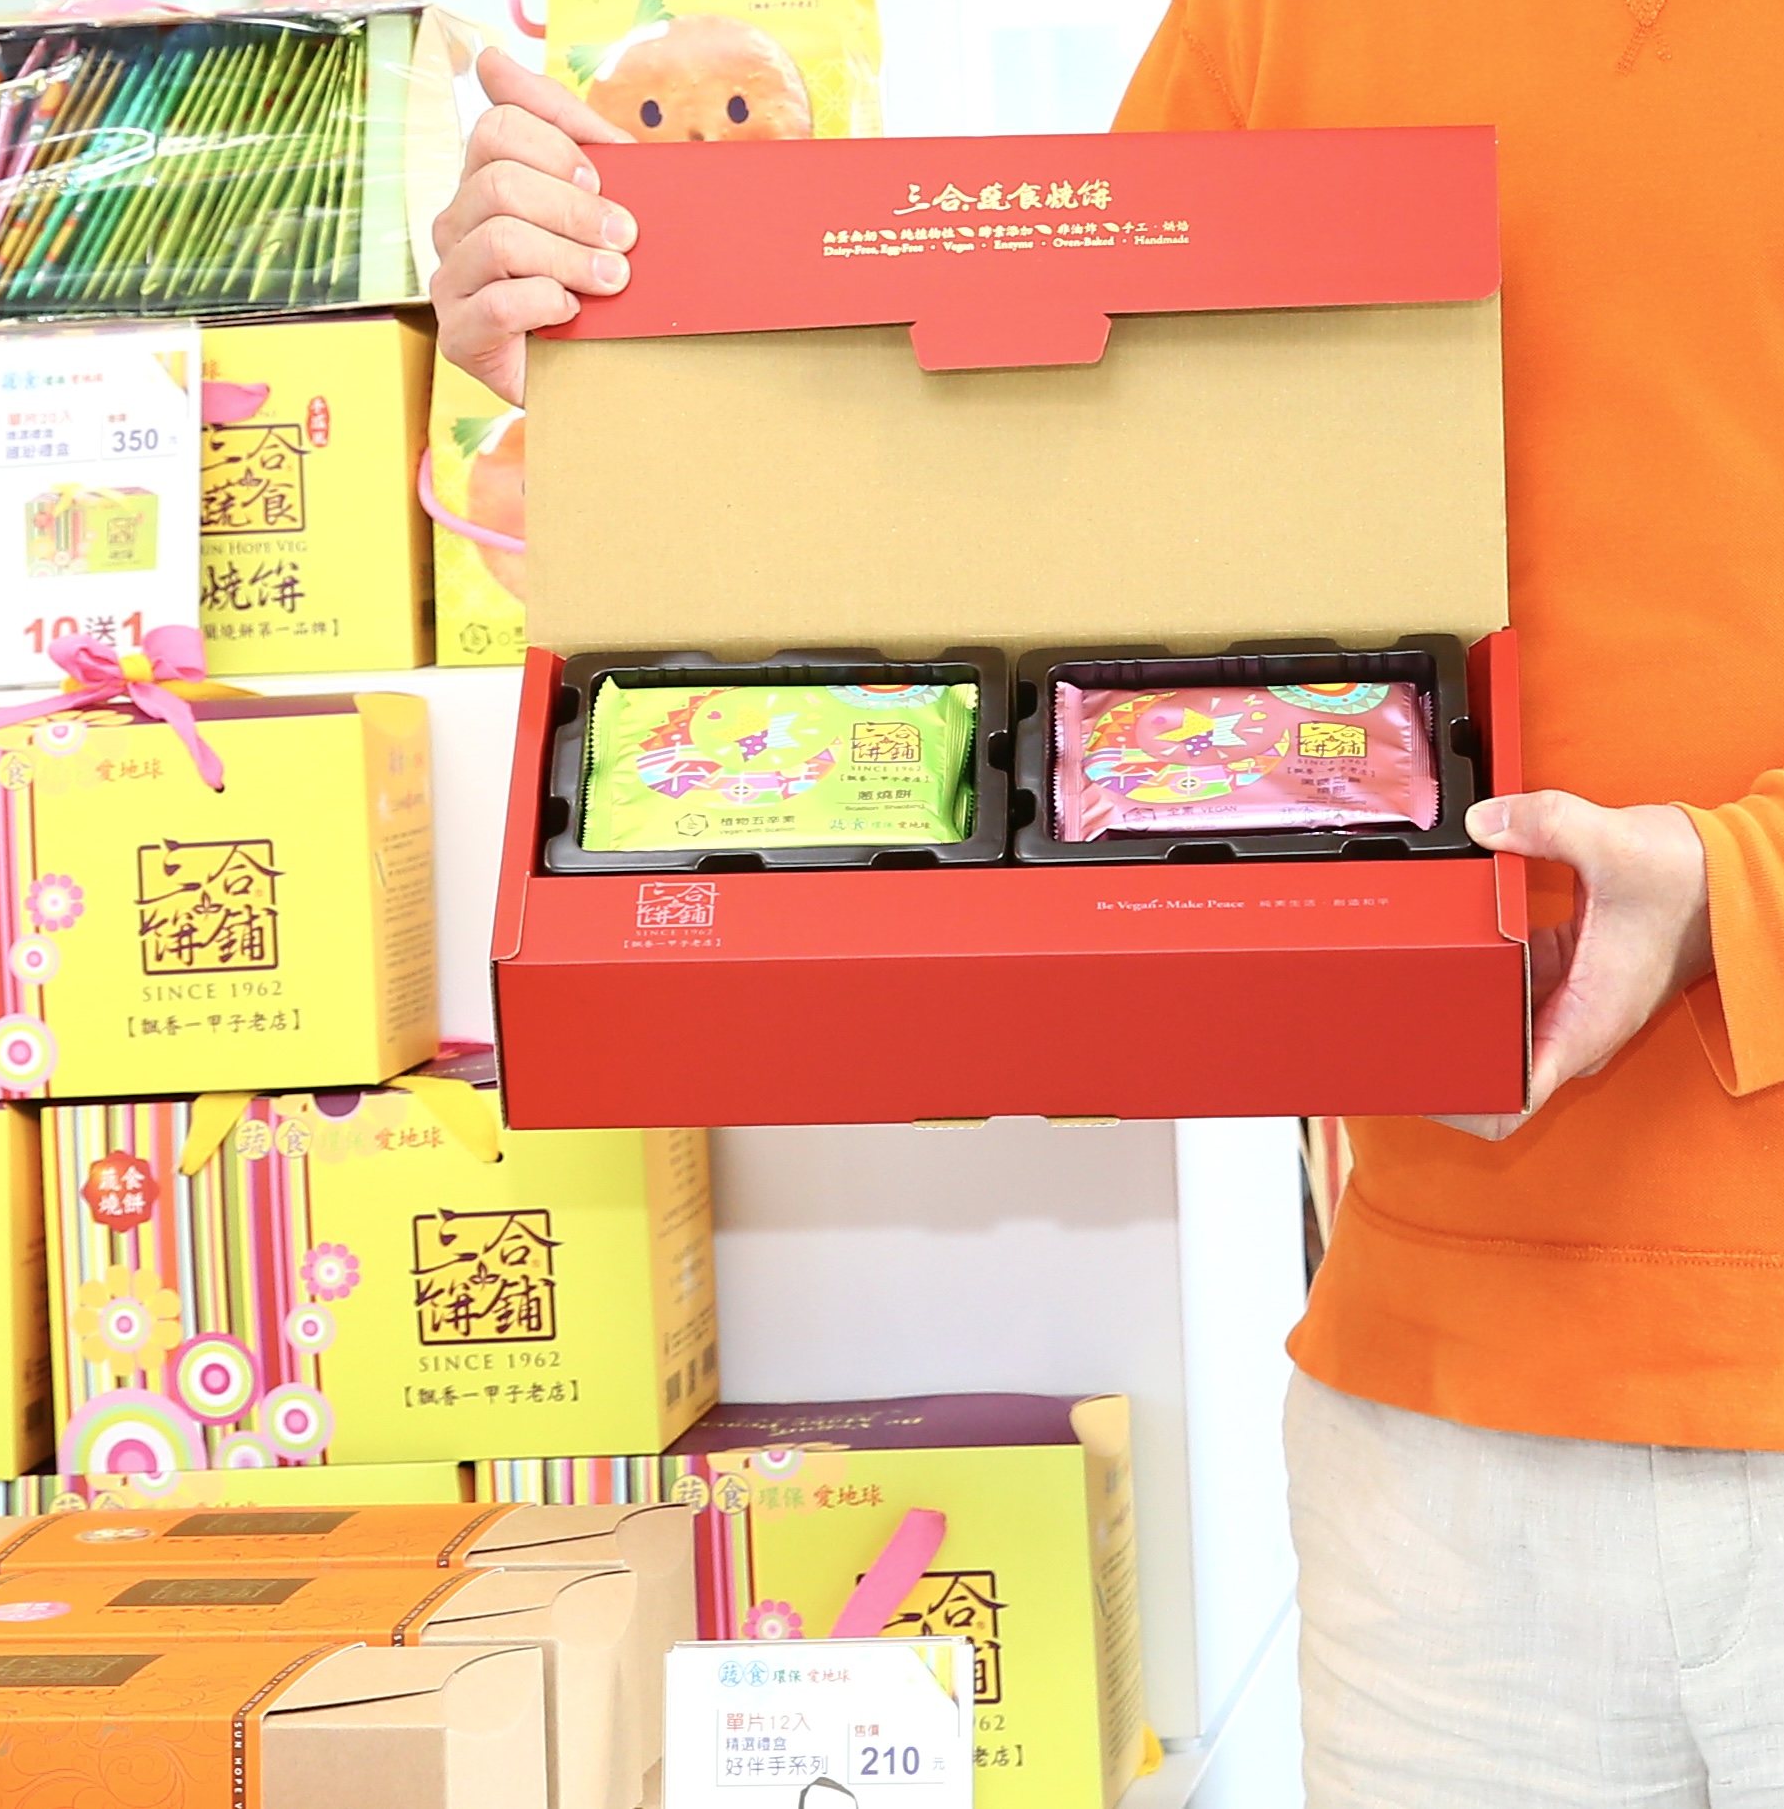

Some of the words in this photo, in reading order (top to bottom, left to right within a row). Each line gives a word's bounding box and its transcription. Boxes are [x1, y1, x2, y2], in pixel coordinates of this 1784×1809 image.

[1056, 222, 1098, 236] 非油炸
[942, 241, 976, 254] Vegan
[993, 239, 1034, 252] Enzyme
[1052, 236, 1115, 248] Oven-Baked
[1134, 234, 1190, 246] Handmade
[111, 428, 159, 453] 350
[229, 540, 271, 554] HOPE
[276, 539, 307, 554] VEG
[94, 758, 165, 783] 愛地球
[1200, 805, 1238, 813] VEGAN
[721, 815, 796, 827] 植物五辛素
[1096, 901, 1115, 910] Be
[1166, 899, 1205, 909] Make
[1208, 899, 1245, 909] Peace
[636, 928, 677, 936] SINCE
[142, 982, 217, 1003] SINCE
[230, 979, 283, 999] 1962
[237, 1121, 311, 1156] 蔬食
[374, 1127, 445, 1152] 愛地球
[98, 1165, 146, 1191] 蔬食
[419, 1353, 495, 1373] SINCE
[507, 1351, 562, 1370] 1962
[759, 1486, 805, 1510] 環保
[813, 1484, 884, 1510] 愛地球
[719, 1662, 768, 1686] 蔬食
[772, 1668, 802, 1684] 環保
[807, 1668, 851, 1684] 愛地球
[726, 1713, 811, 1733] 單片12入
[854, 1724, 880, 1738] 售價
[233, 1722, 243, 1748] SUN
[725, 1736, 787, 1752] 精選禮盒
[725, 1755, 828, 1777] 好伴手系列
[860, 1747, 920, 1776] 210
[932, 1757, 946, 1771] 元
[233, 1757, 243, 1794] HOPE
